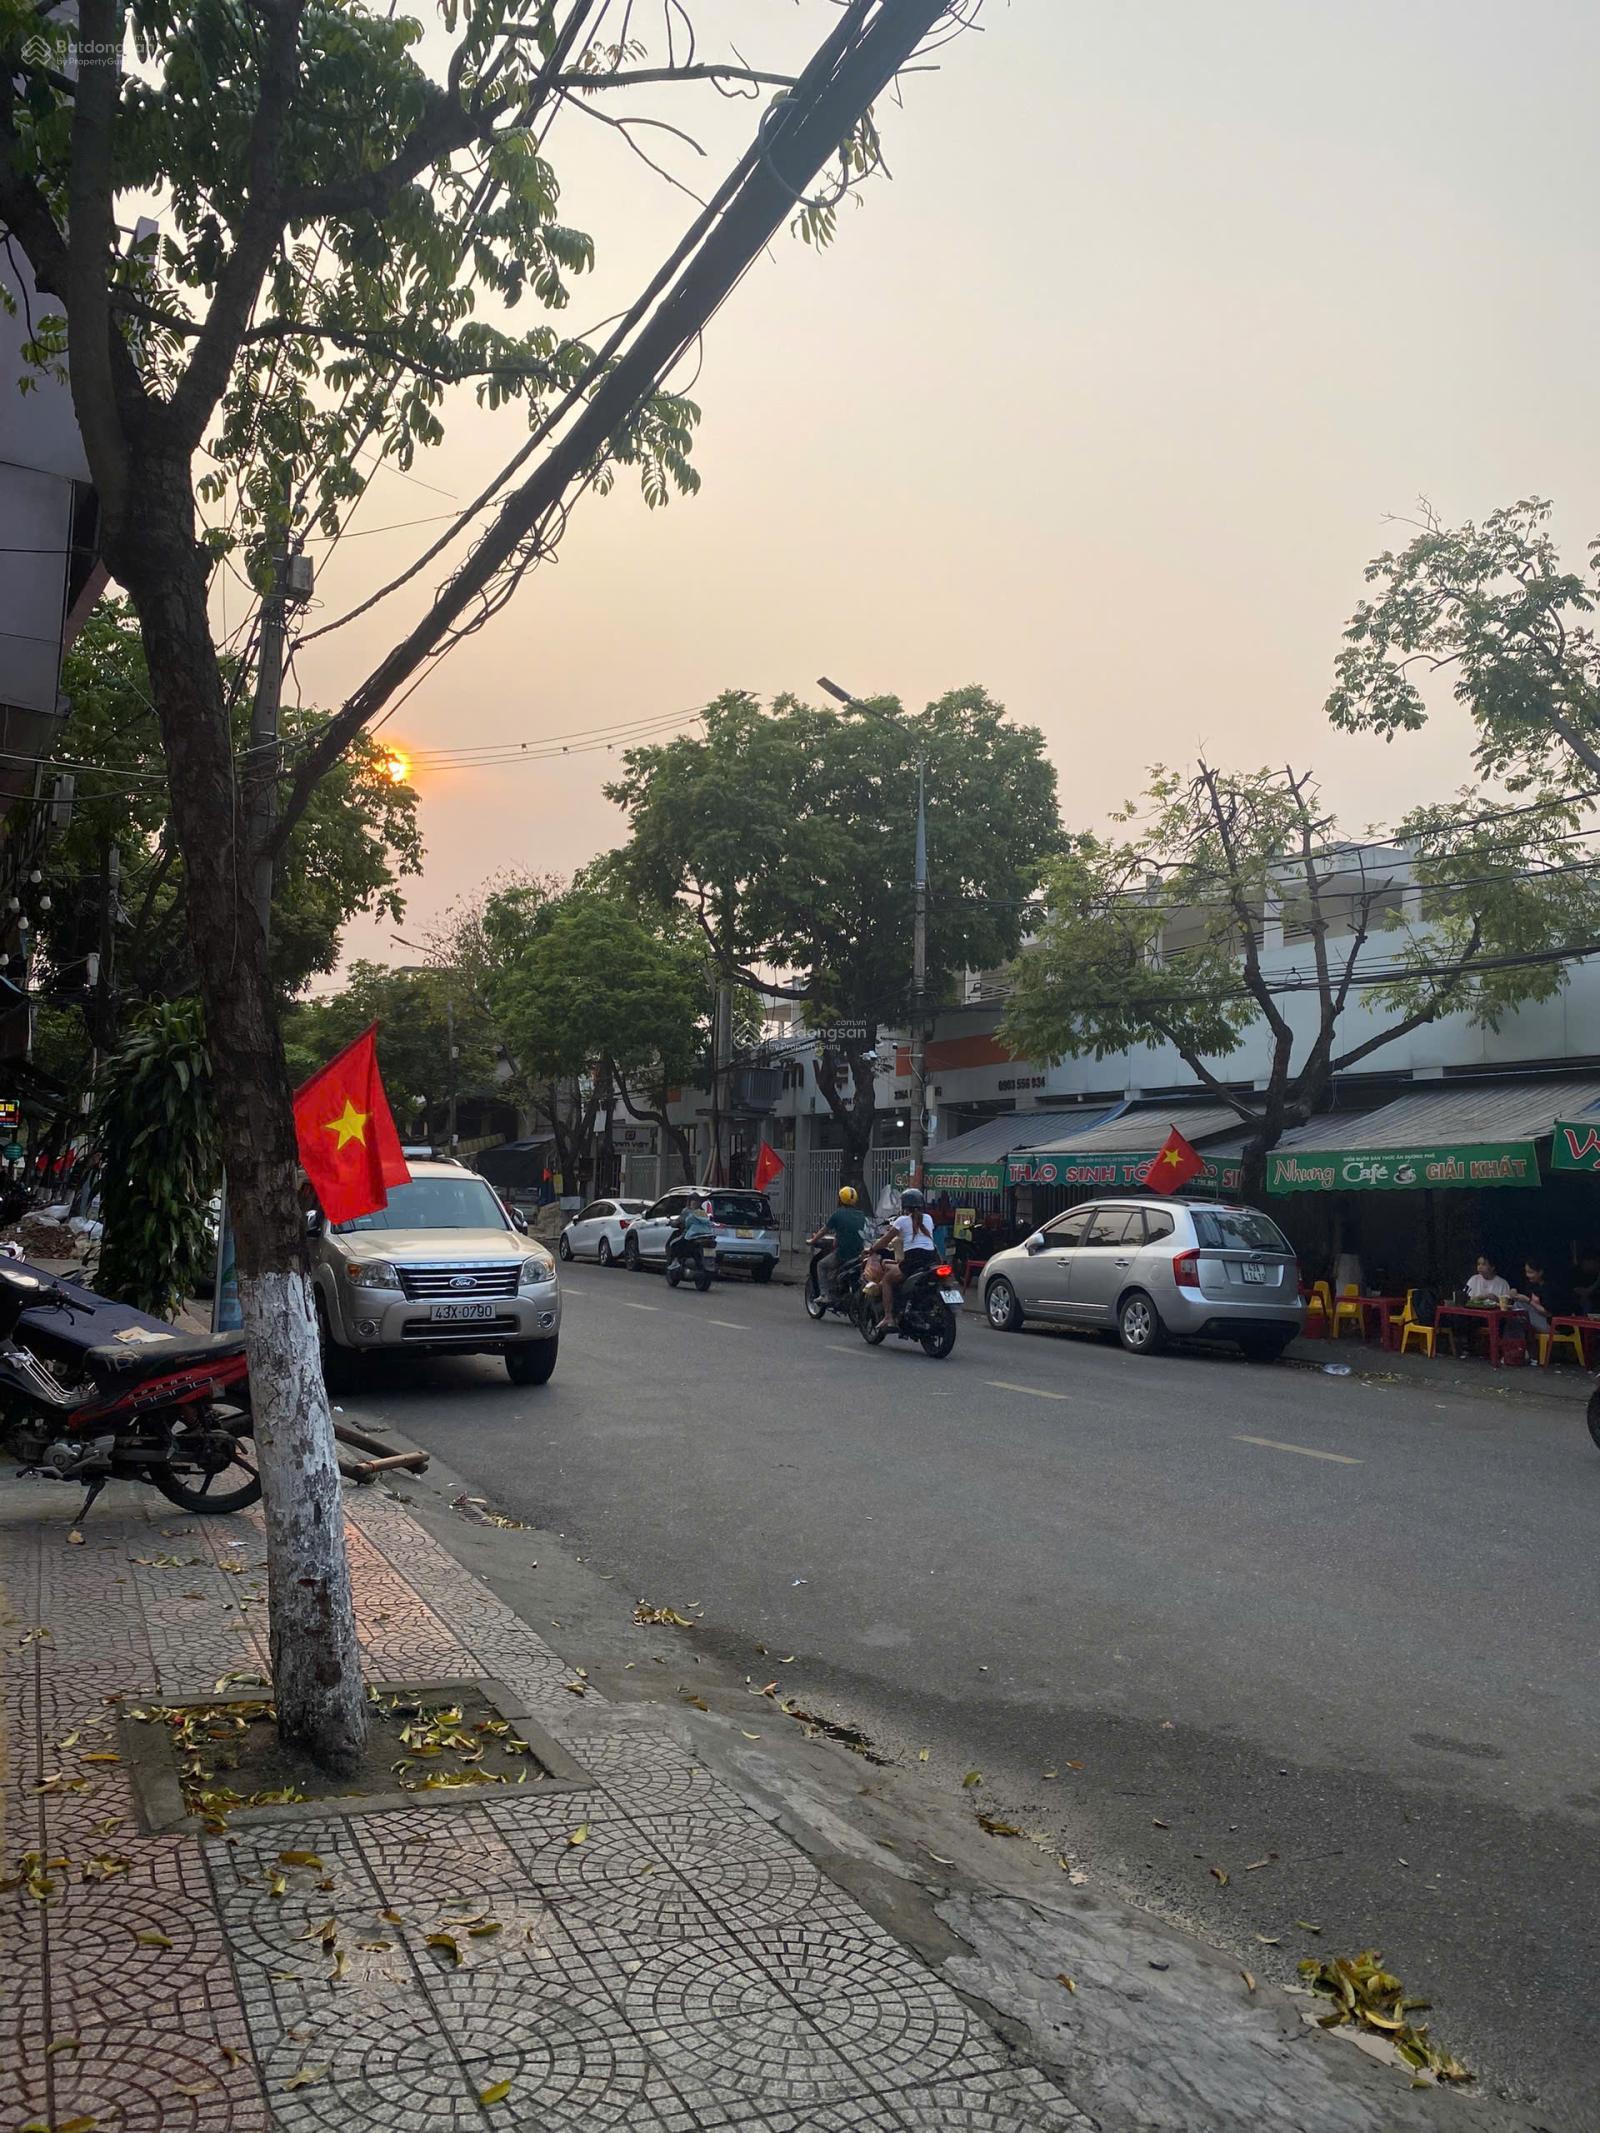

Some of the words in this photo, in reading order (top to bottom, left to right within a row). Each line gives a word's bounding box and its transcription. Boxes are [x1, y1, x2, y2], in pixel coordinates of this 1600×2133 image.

[934, 1171, 967, 1188] CHIÊN
[1066, 1165, 1116, 1182] SINH
[1274, 1158, 1335, 1188] Nhung
[1342, 1162, 1389, 1184] Café
[1425, 1156, 1465, 1180] GIẢI
[1470, 1154, 1527, 1179] KHÁT
[435, 1305, 492, 1319] 43X-0790
